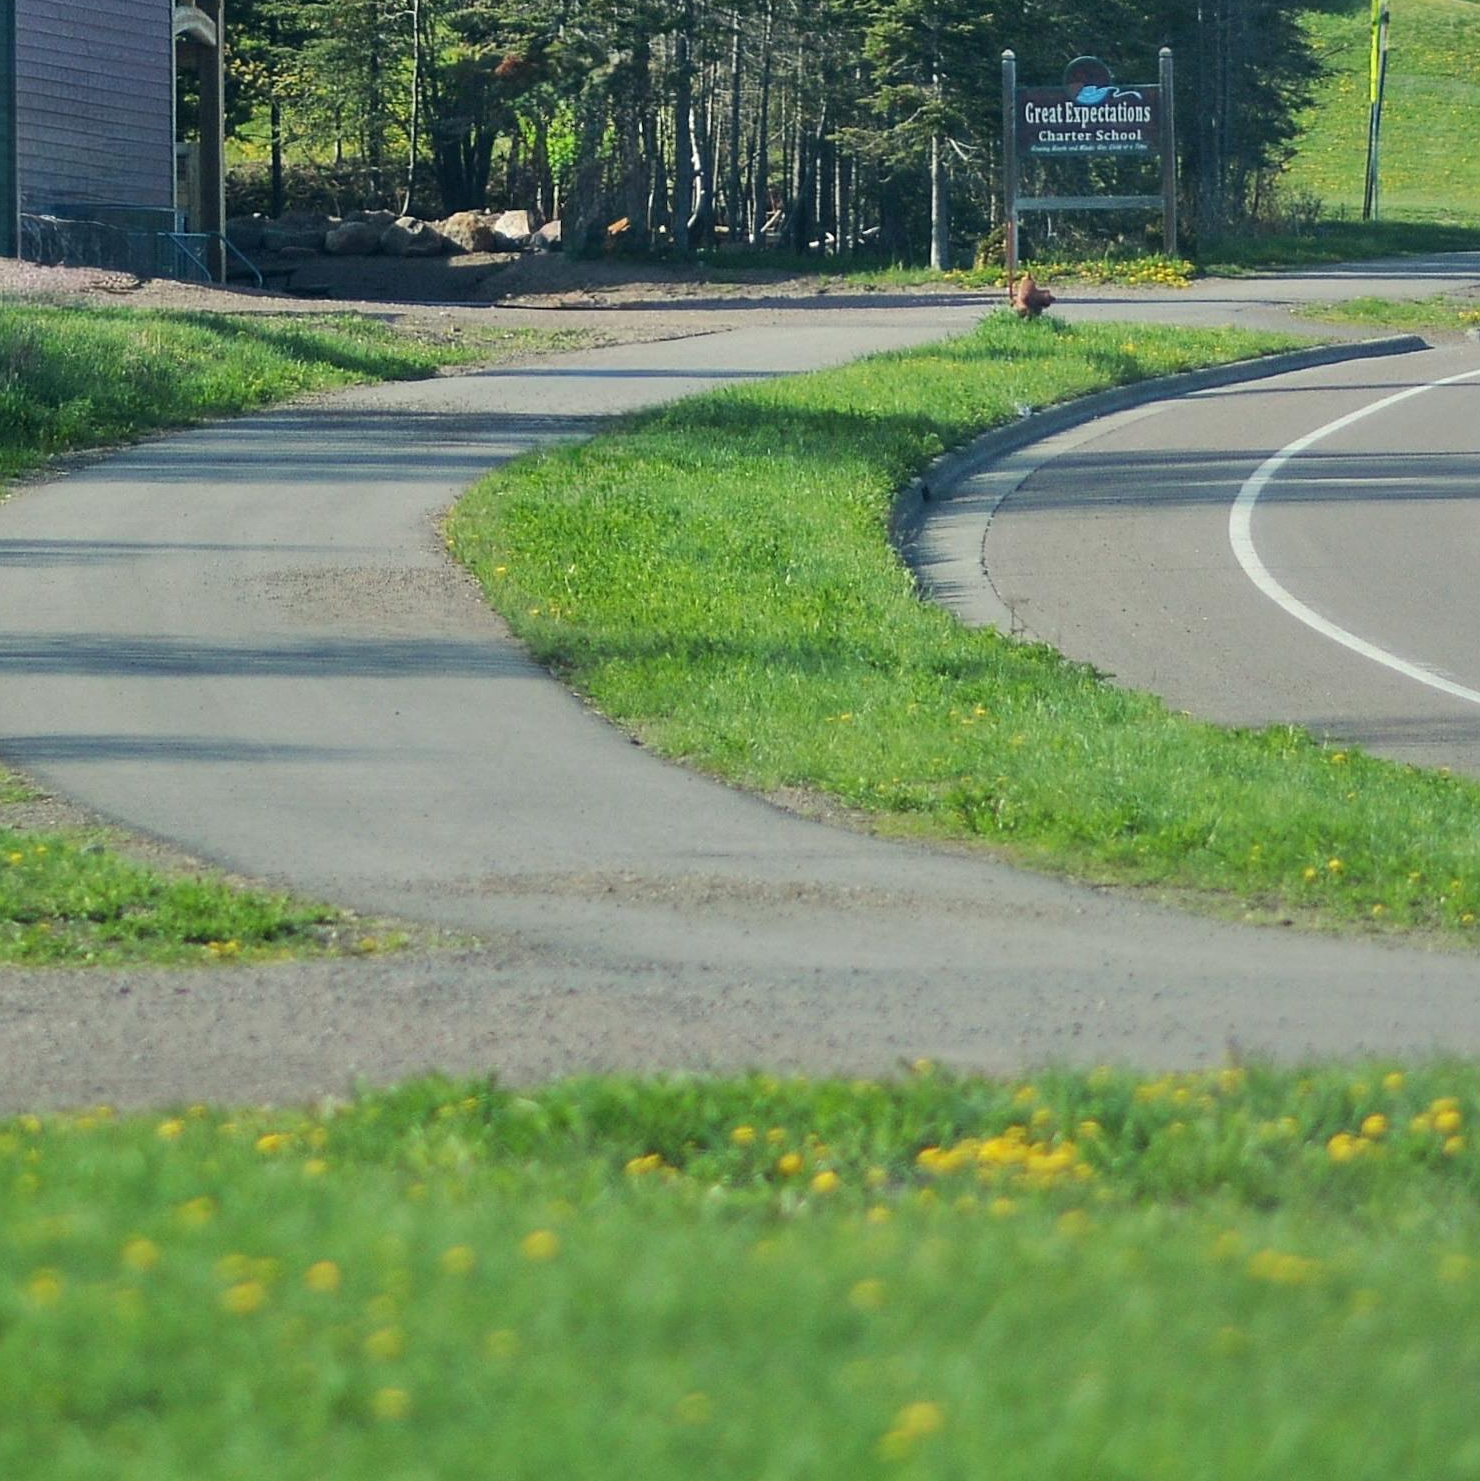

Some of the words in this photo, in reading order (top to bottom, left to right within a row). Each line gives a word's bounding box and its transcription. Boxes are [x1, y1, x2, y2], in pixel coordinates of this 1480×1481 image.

[1025, 101, 1063, 123] Great
[1065, 101, 1151, 128] Expectations
[1038, 130, 1092, 141] Charter
[1096, 129, 1142, 141] School
